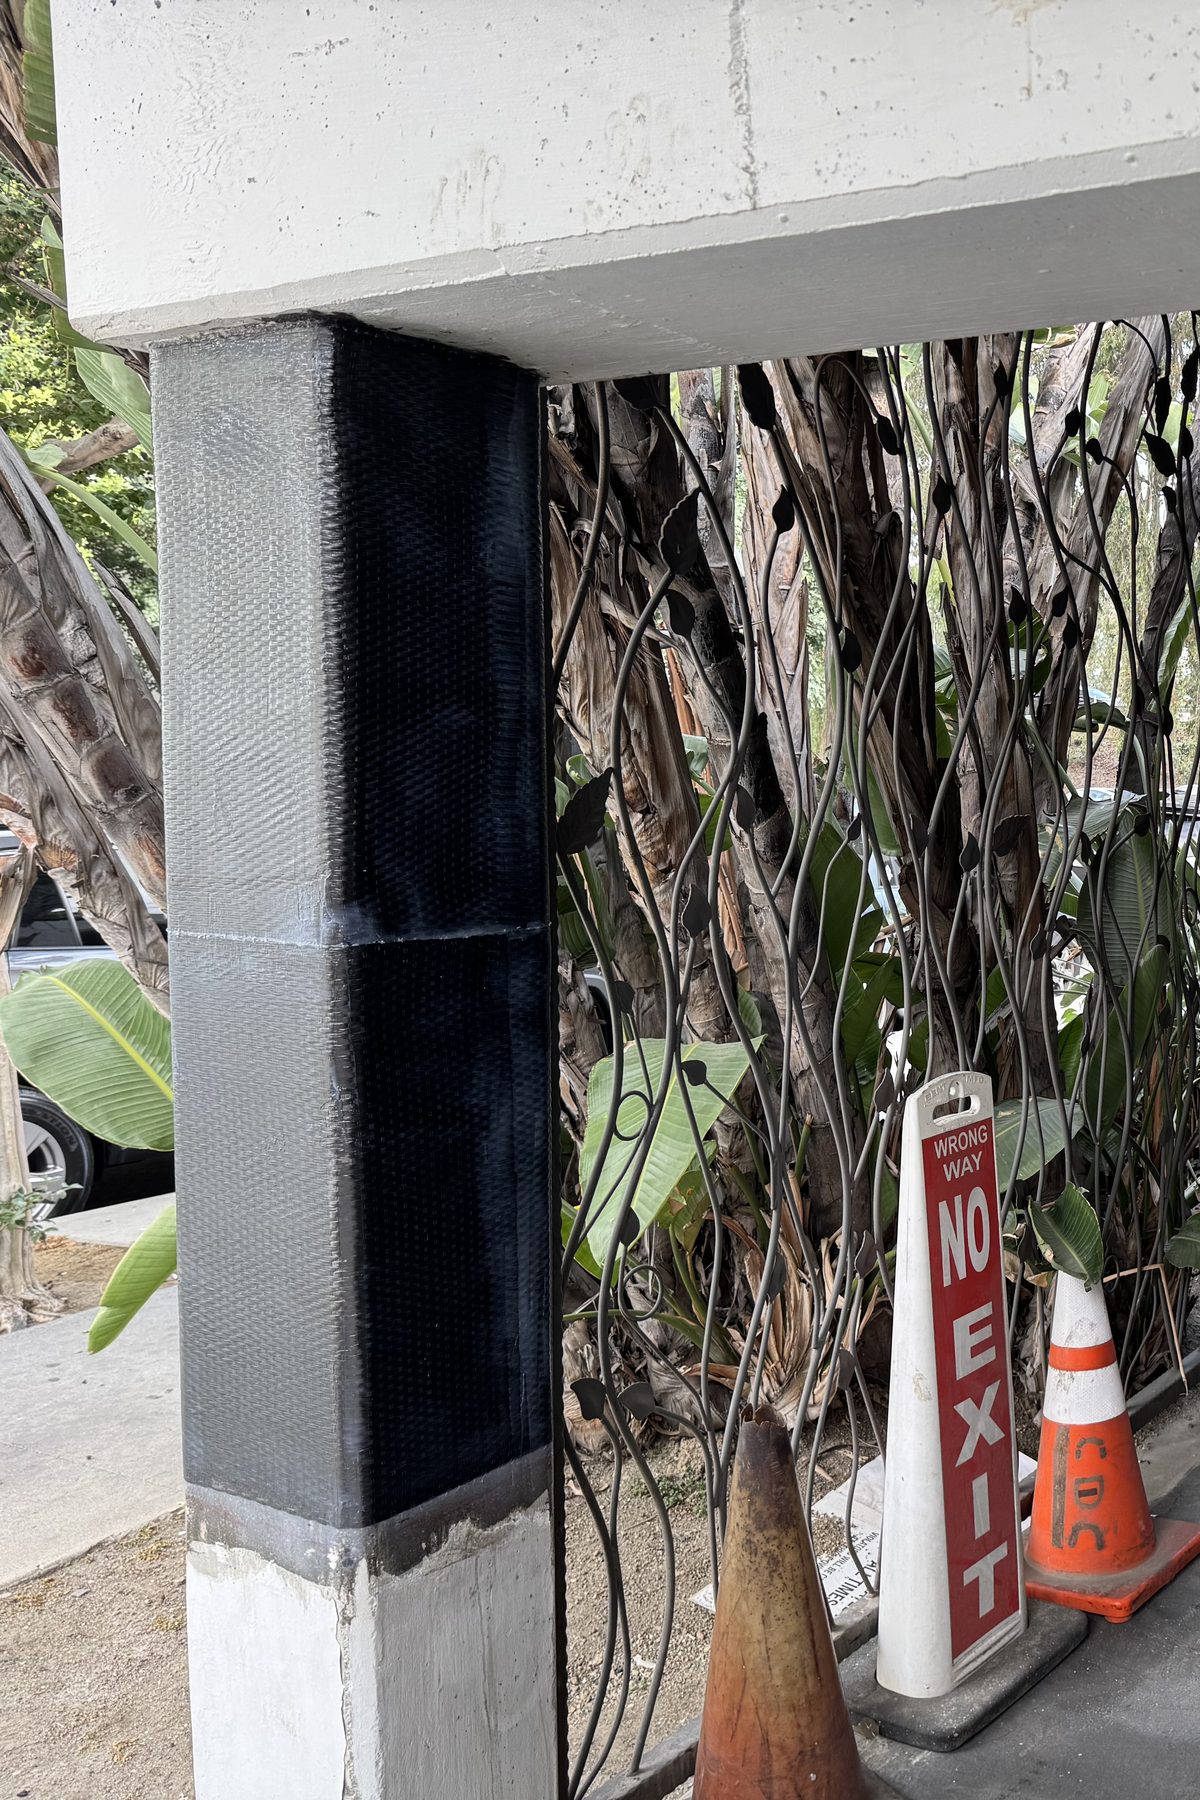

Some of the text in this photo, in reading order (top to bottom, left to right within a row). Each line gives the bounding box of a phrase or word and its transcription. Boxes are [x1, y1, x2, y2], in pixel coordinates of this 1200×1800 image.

[934, 1125, 988, 1159] WRONG
[943, 1151, 982, 1182] WAY
[938, 1187, 990, 1287] NO
[953, 1301, 1008, 1619] EXIT
[847, 1531, 879, 1556] VIOLATO
[827, 1576, 864, 1606] TIMES
